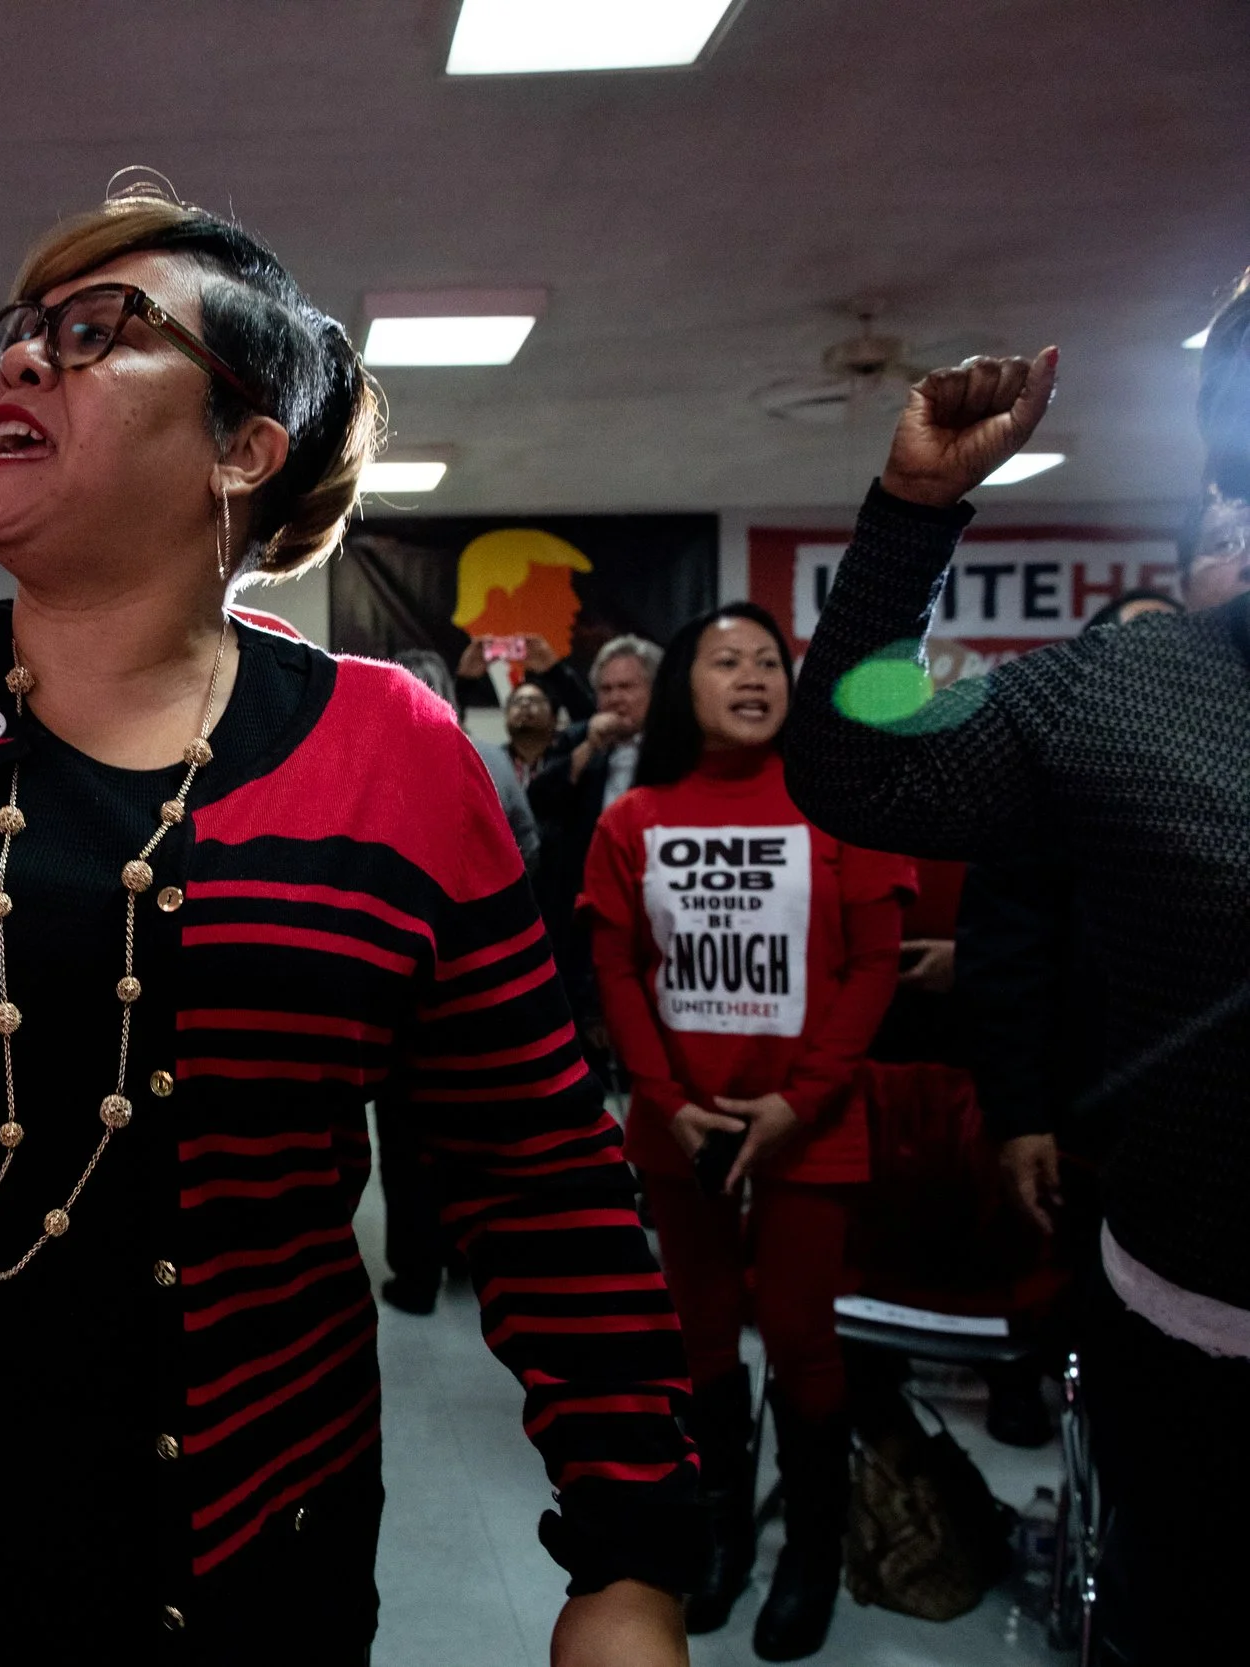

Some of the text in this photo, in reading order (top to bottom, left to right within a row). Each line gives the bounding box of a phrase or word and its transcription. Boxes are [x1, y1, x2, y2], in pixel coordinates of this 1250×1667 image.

[659, 838, 787, 867] ONE
[669, 871, 774, 891] JOB
[680, 896, 763, 911] SHOULD
[708, 914, 732, 929] BE
[671, 999, 779, 1018] UNITEHERE!
